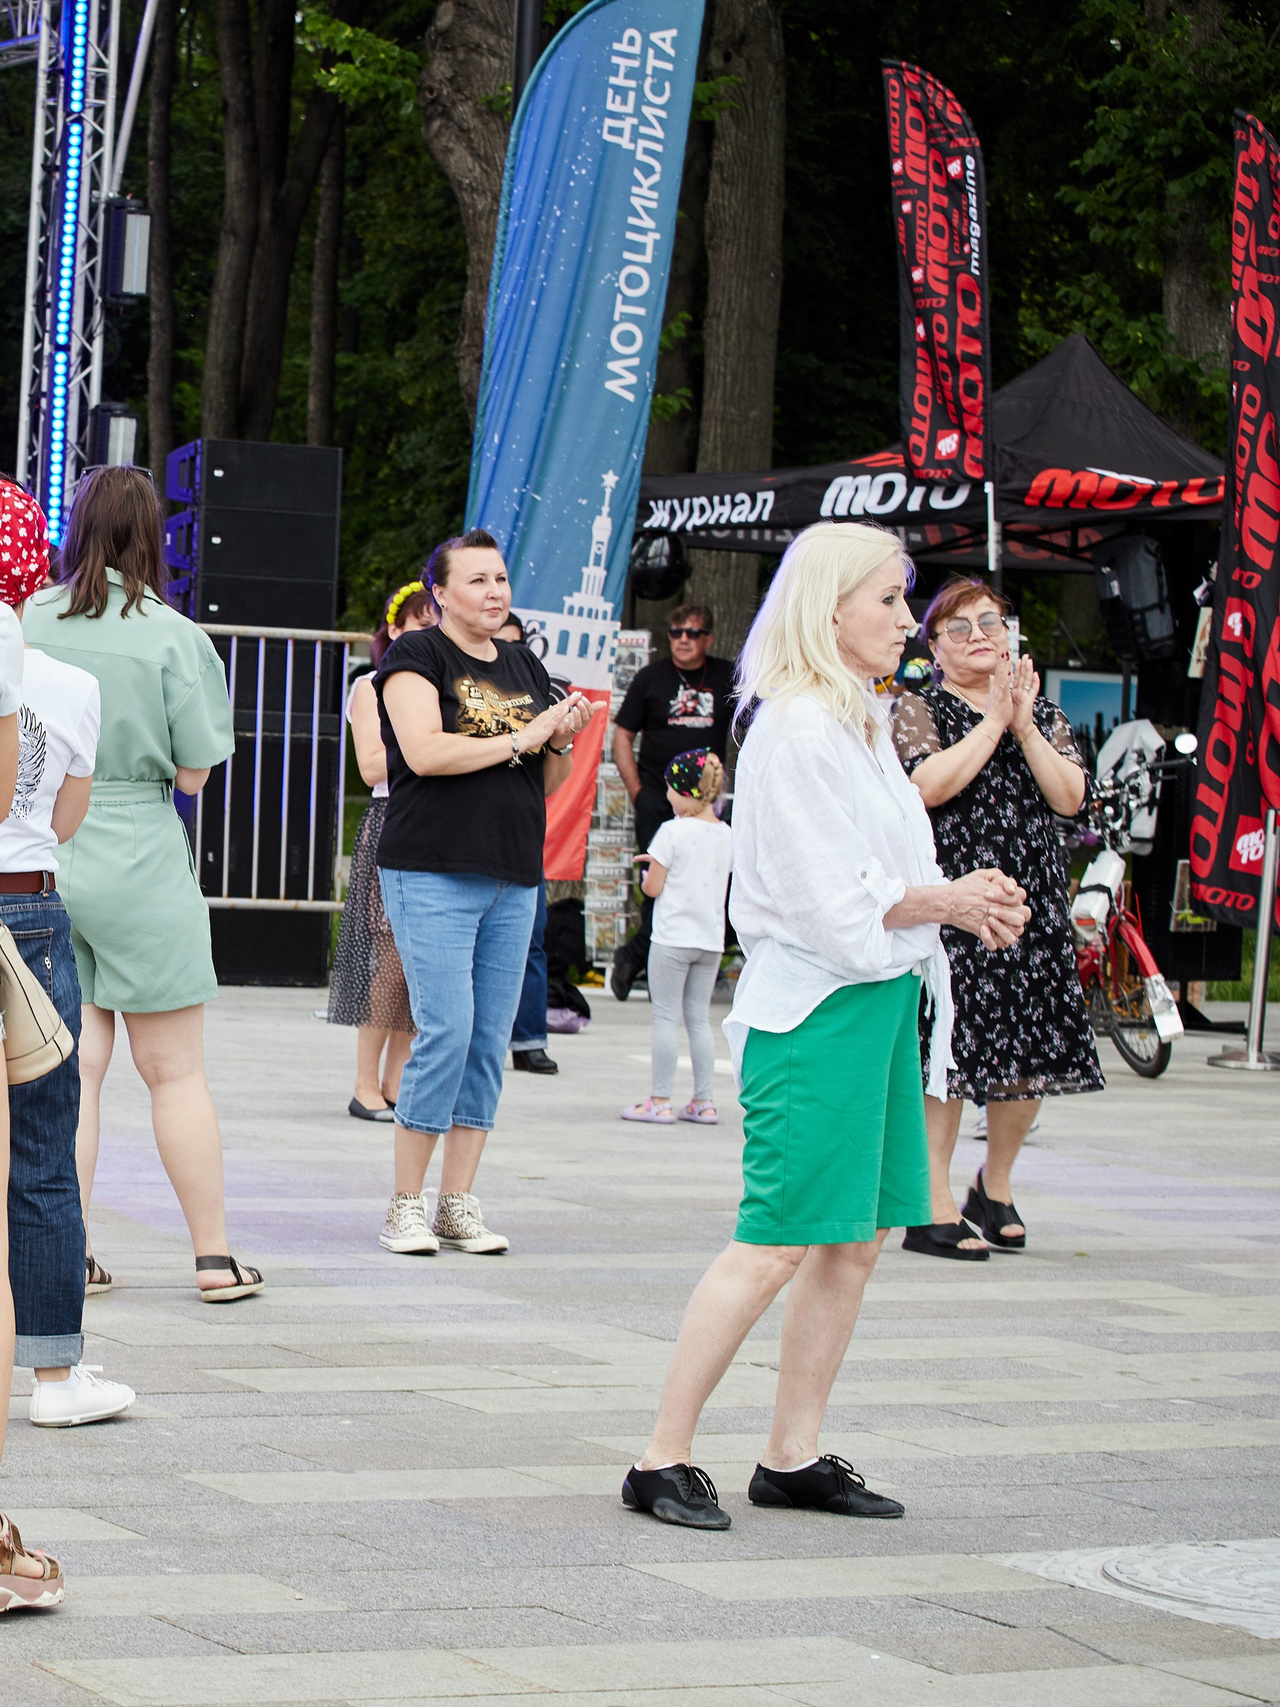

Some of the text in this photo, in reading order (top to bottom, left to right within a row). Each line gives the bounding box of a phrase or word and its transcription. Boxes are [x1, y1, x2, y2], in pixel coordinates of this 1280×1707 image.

[602, 27, 643, 150] ДЕНЬ
[603, 28, 679, 403] МОТОЦИКЛИСТА
[927, 147, 950, 296] MOTO
[963, 153, 982, 276] magazine
[909, 347, 933, 467] MOTO
[956, 272, 984, 480] MOTO
[643, 490, 775, 532] журнал
[1189, 651, 1247, 879] MOTO
[1191, 881, 1256, 911] MOTO
